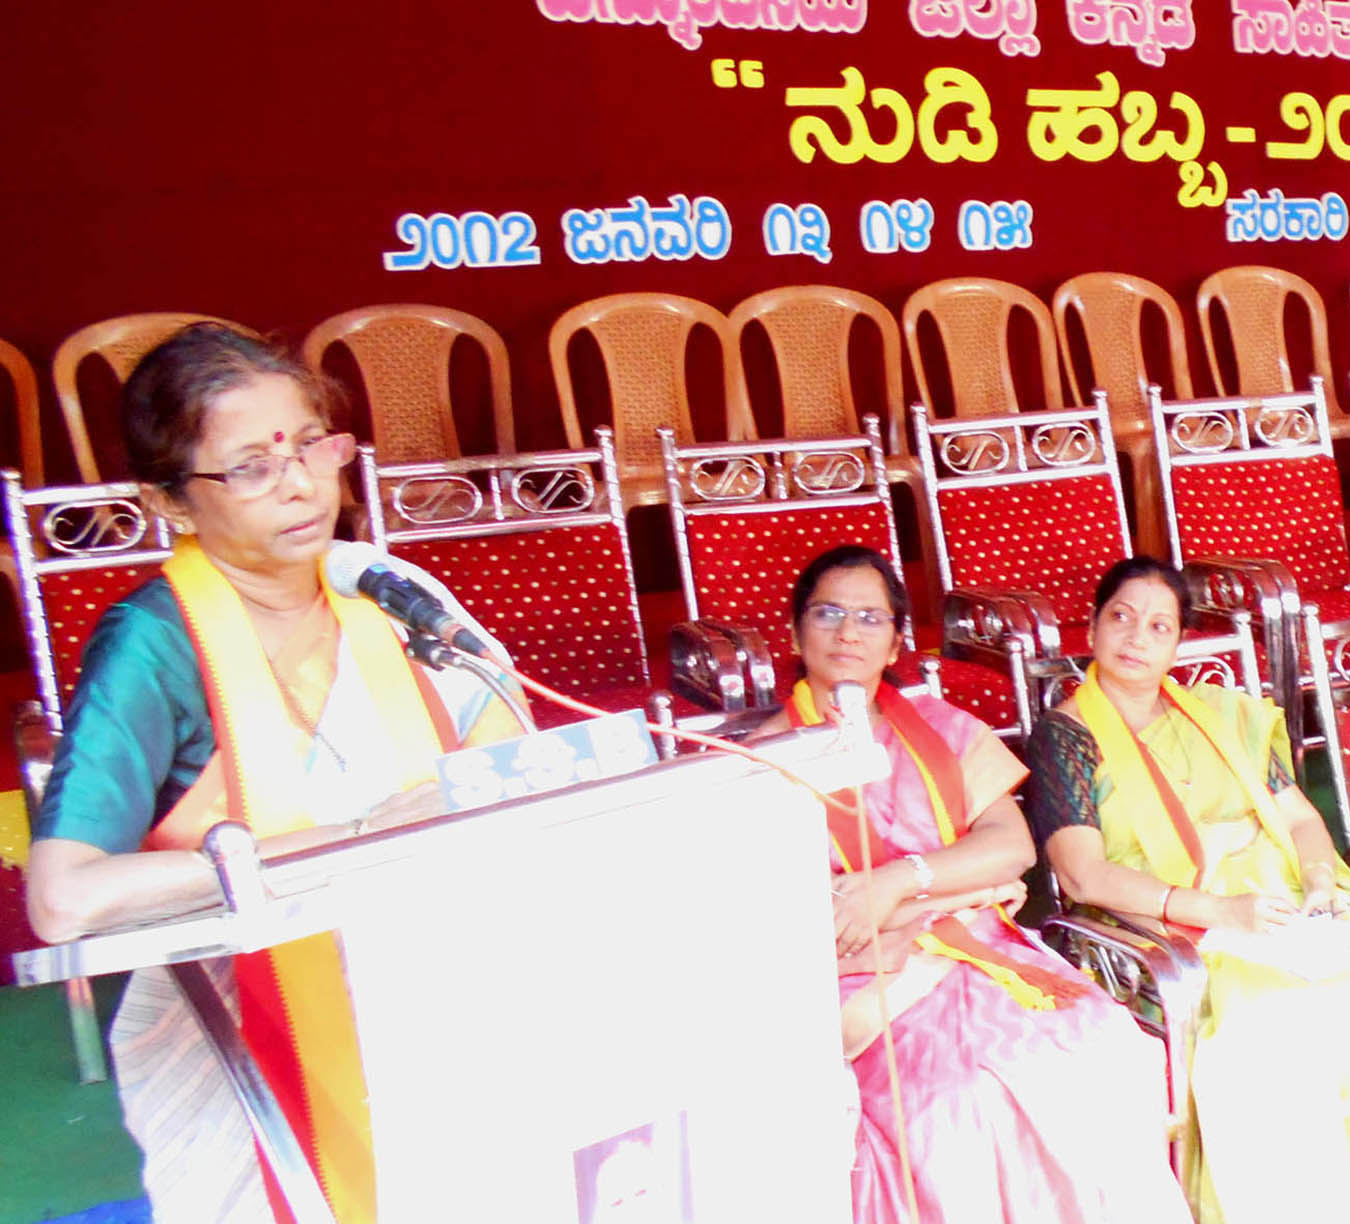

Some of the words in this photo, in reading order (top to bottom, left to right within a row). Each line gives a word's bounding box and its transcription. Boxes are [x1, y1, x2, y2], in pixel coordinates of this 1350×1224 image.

[1066, 0, 1195, 67] ಕನ್ನಡ
[561, 194, 732, 264] ಜನವರಿ
[860, 199, 934, 253] ೧೪
[1226, 188, 1349, 242] ಸರಕಾರಿ
